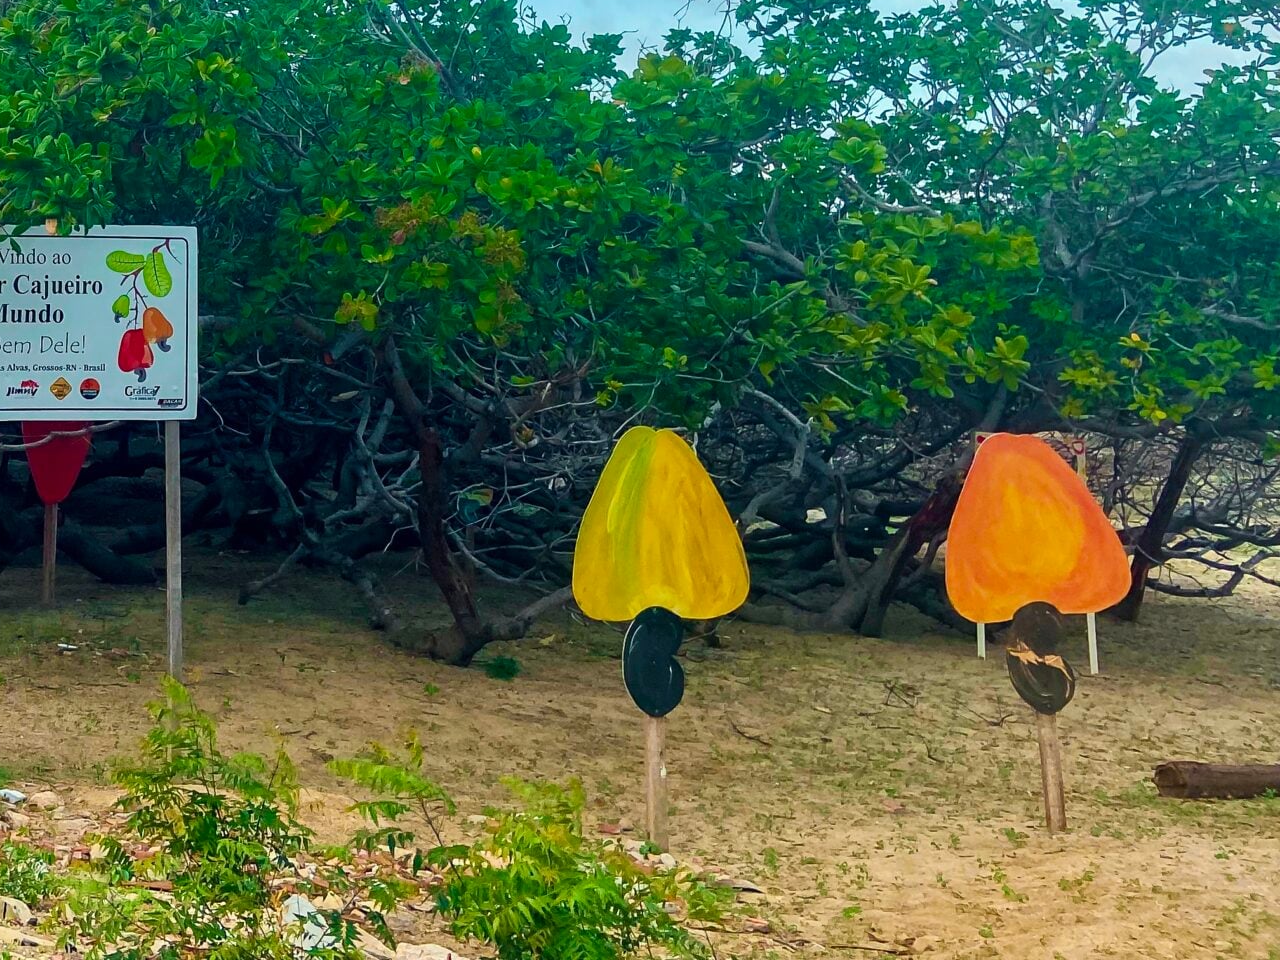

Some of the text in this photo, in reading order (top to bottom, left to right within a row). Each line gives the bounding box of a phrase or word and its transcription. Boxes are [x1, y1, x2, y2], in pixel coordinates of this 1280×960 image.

[53, 253, 70, 264] ao
[13, 273, 102, 299] Cajueiro
[40, 332, 86, 355] Dele!
[7, 363, 30, 373] Alvas,
[32, 363, 77, 372] Grossos-RN
[83, 362, 106, 371] Brasil
